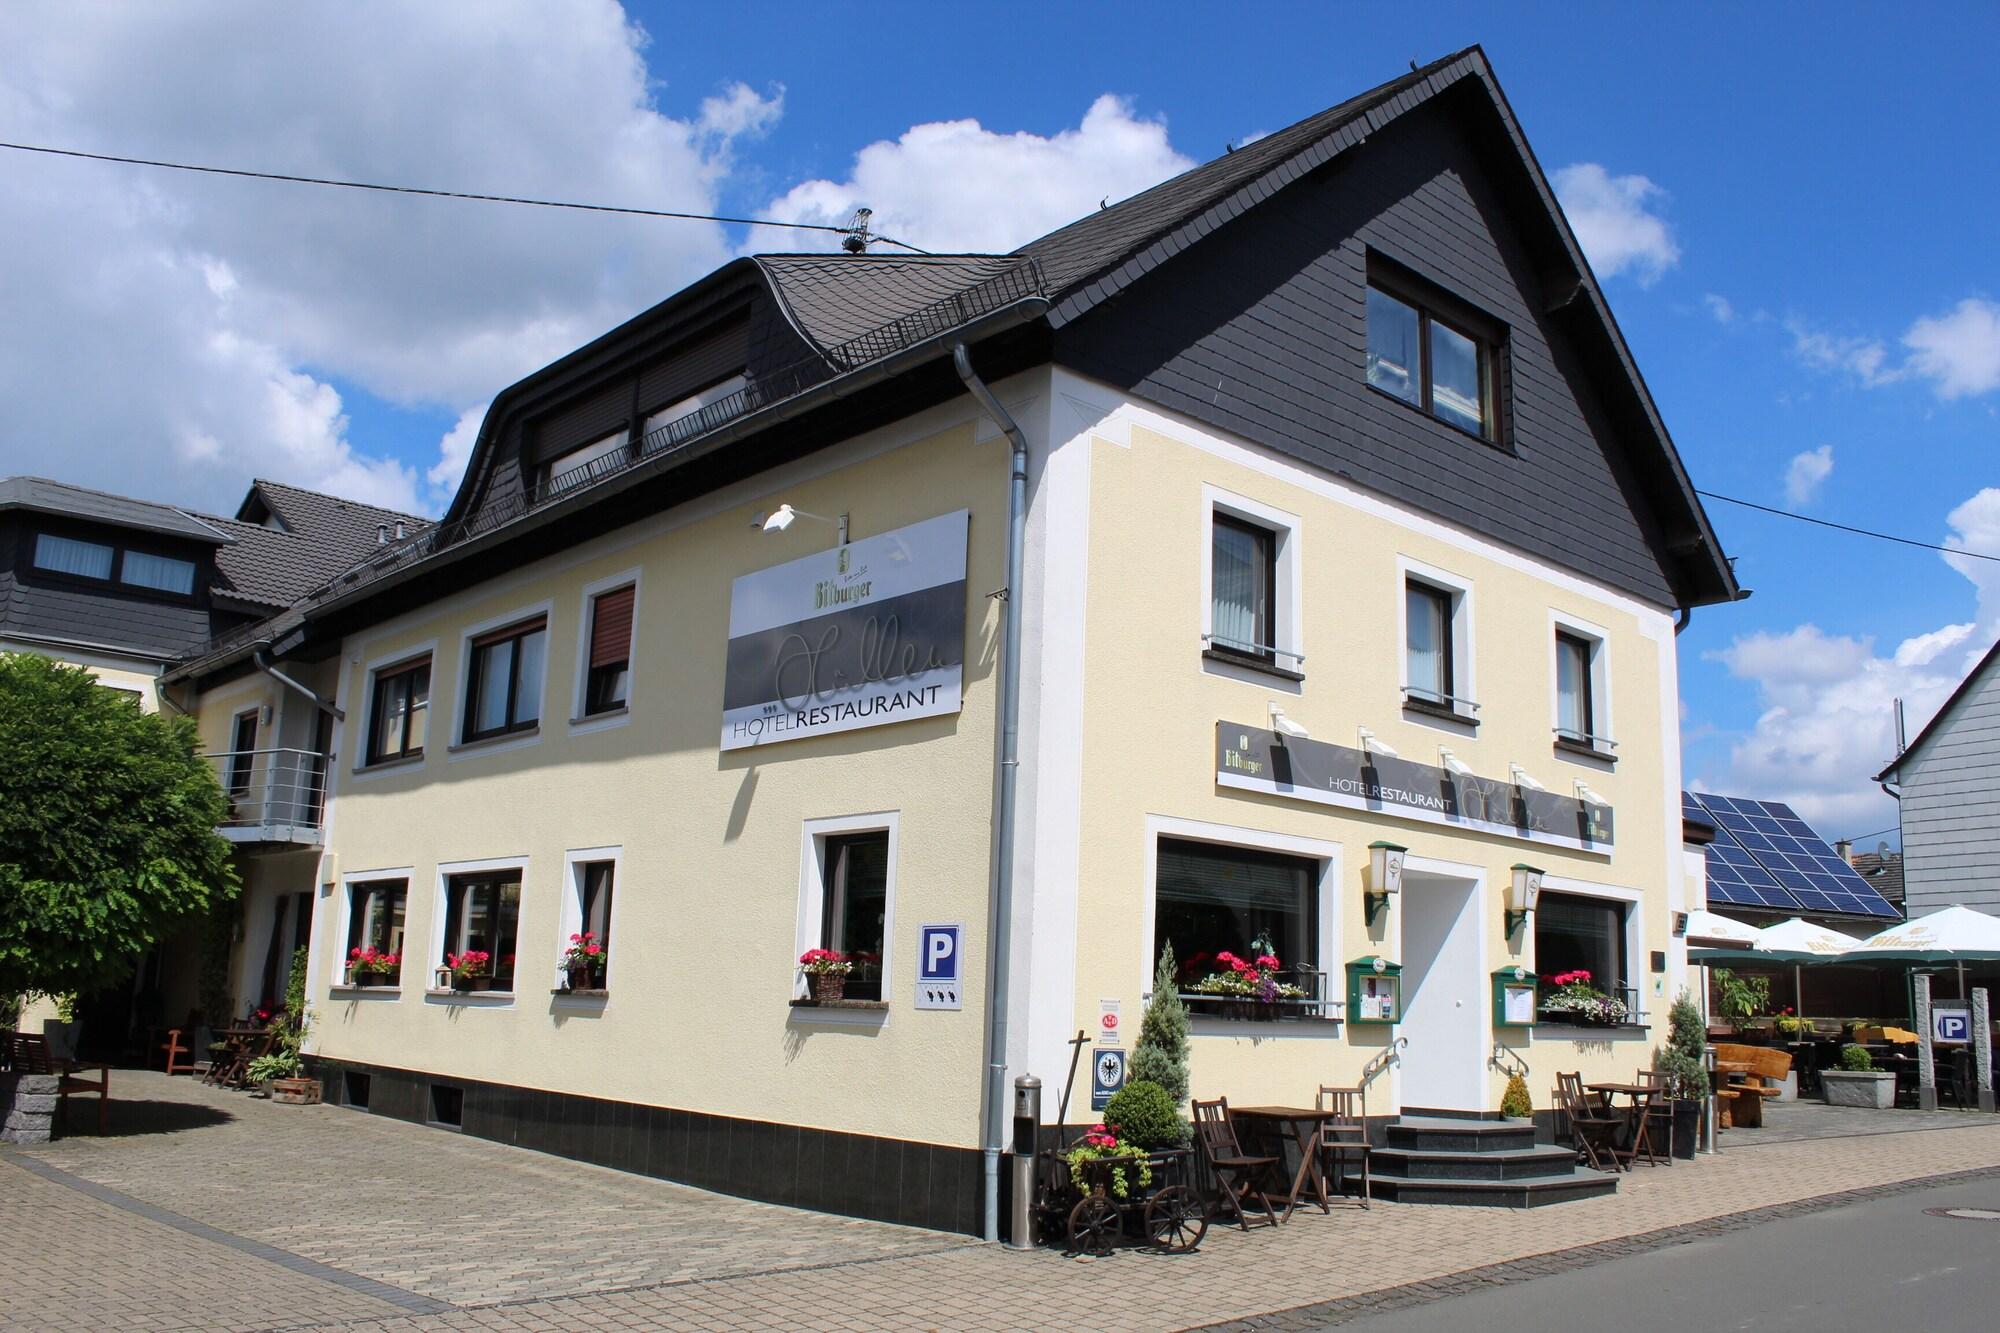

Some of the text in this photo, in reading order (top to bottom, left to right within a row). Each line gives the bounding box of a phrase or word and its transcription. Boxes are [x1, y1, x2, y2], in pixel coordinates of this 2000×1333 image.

[815, 579, 872, 609] Bitburger
[1225, 748, 1263, 774] Bitburger
[928, 932, 954, 972] P
[1945, 1018, 1964, 1037] P
